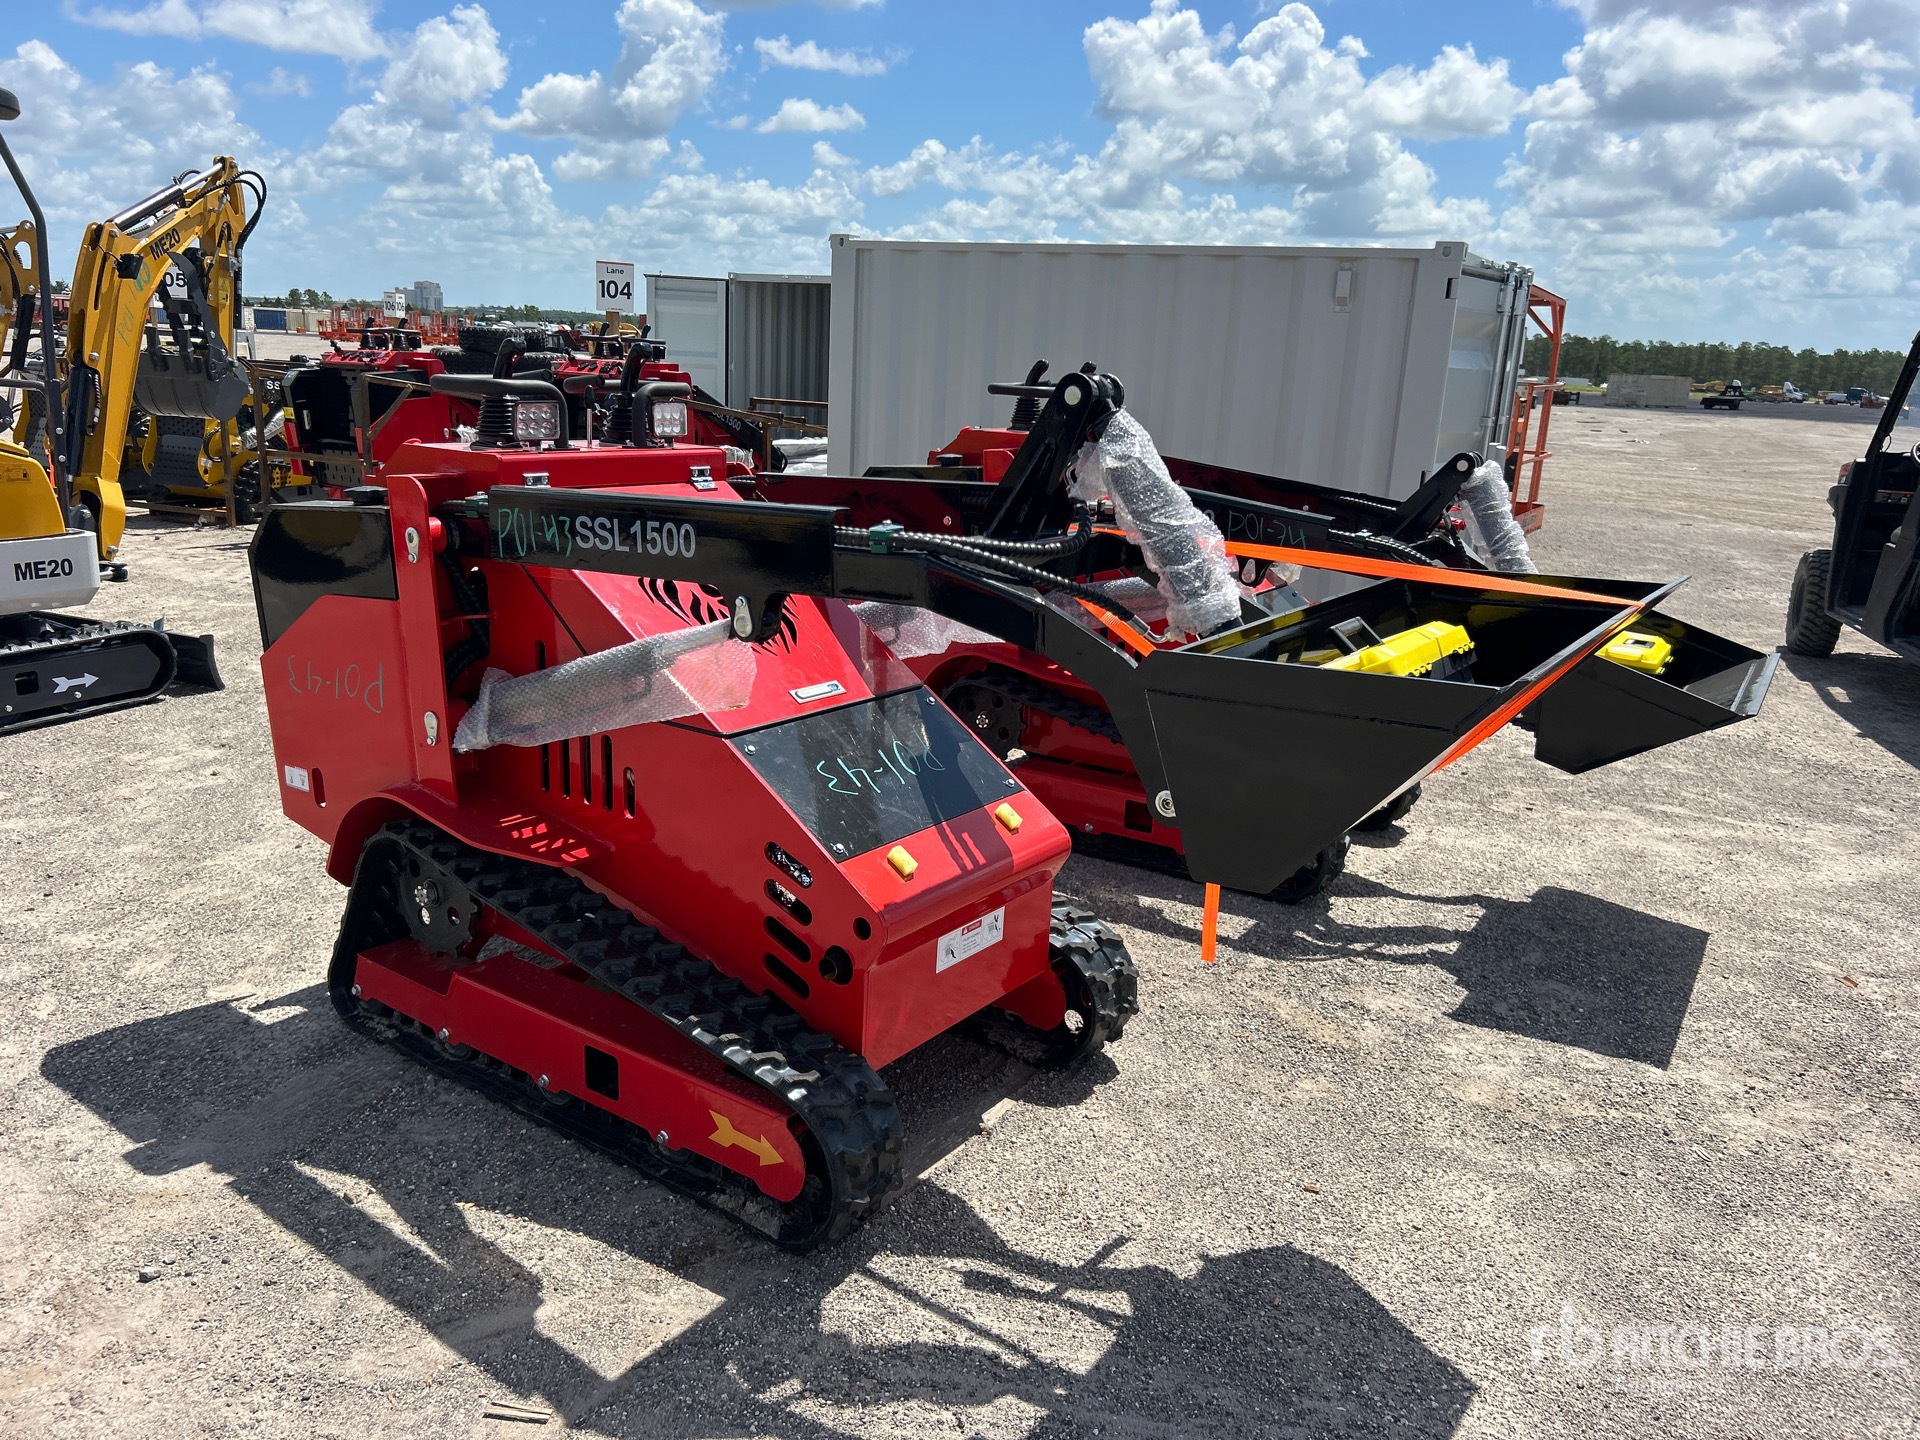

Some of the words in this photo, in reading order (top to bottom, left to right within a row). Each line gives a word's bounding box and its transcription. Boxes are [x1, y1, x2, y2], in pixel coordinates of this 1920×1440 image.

[149, 228, 181, 261] ME20
[162, 271, 188, 288] 05
[606, 266, 625, 275] Lane
[598, 279, 632, 300] 104
[384, 300, 396, 311] 106
[575, 515, 696, 559] SSL1500
[14, 558, 74, 582] ME20
